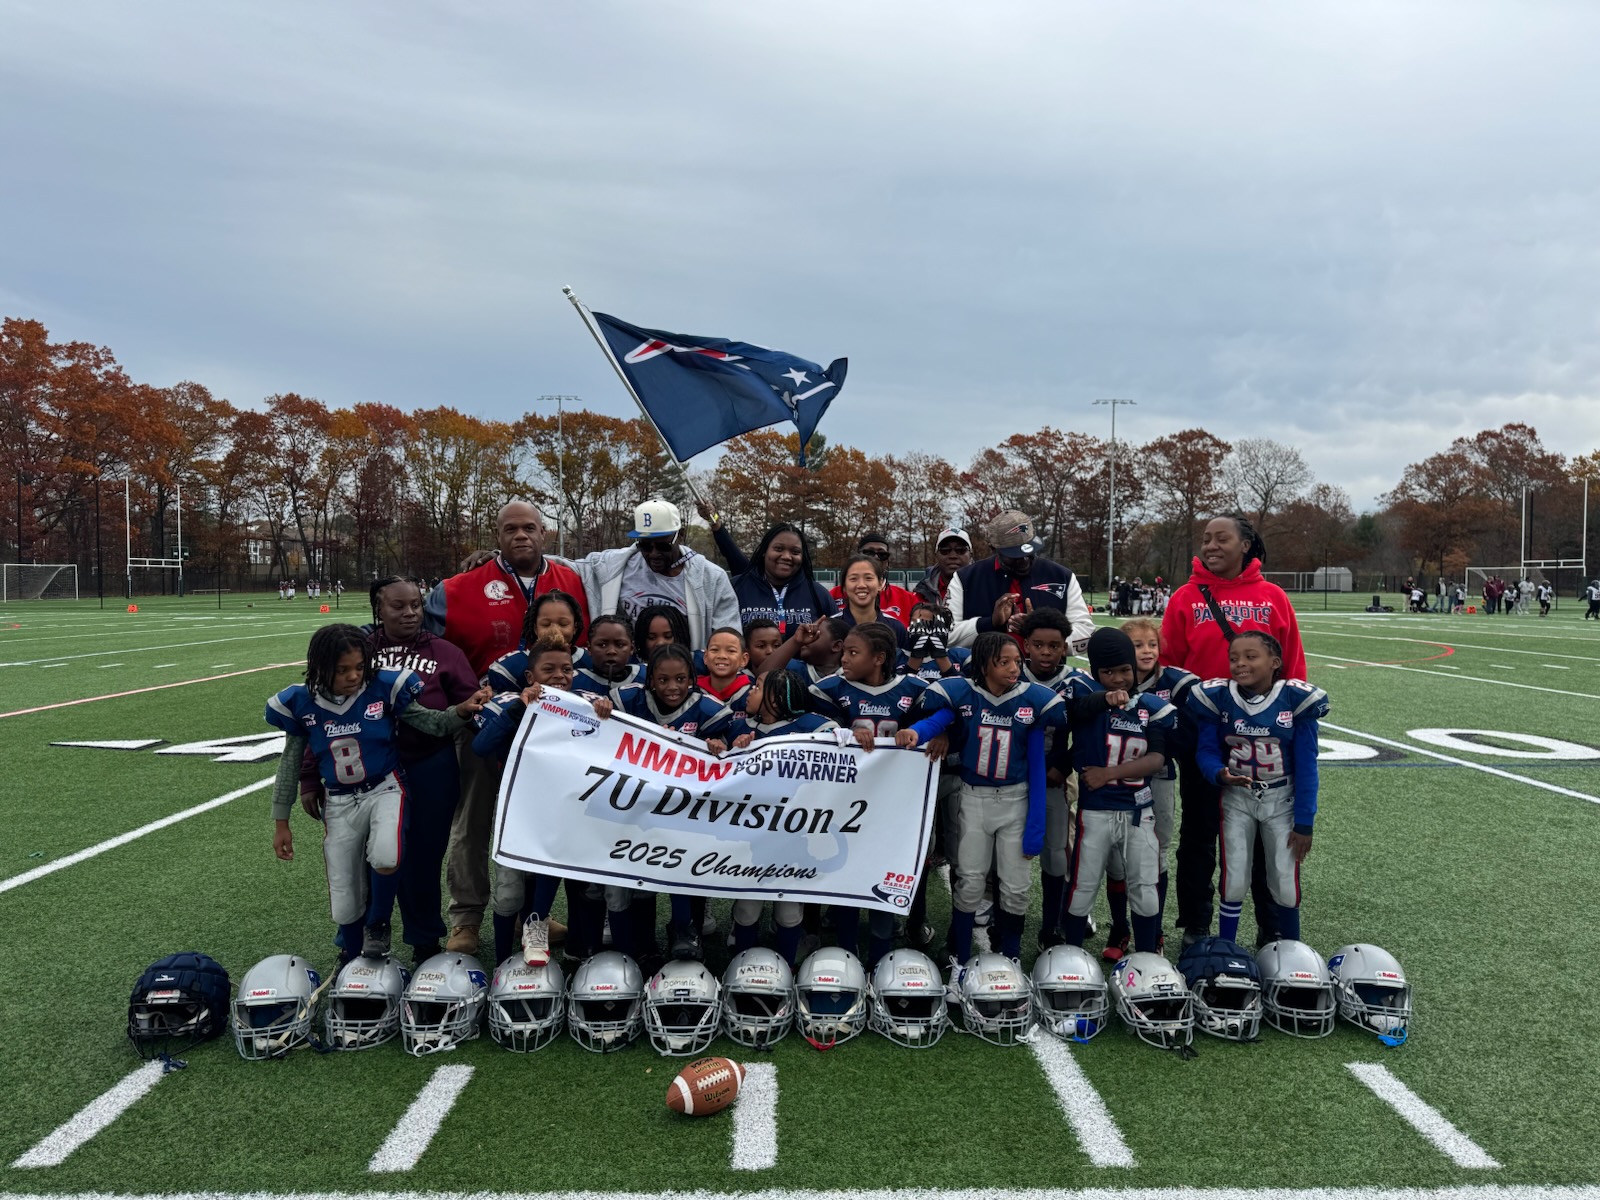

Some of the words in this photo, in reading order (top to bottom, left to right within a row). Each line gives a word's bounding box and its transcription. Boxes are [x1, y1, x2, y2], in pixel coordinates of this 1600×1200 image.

[643, 513, 652, 527] B
[1194, 605, 1272, 628] PARIOTS
[329, 737, 367, 785] 8
[614, 732, 733, 782] NMPW
[735, 749, 837, 768] NORTHEASTERN
[838, 753, 857, 767] MA
[976, 725, 1012, 780] 11
[1225, 735, 1285, 780] 29
[732, 759, 774, 776] POP
[777, 760, 858, 784] WARNER
[577, 765, 650, 811] 7U
[650, 784, 835, 834] Division
[839, 799, 868, 834] 2
[609, 839, 688, 869] 2025
[690, 851, 818, 883] Champions
[883, 881, 911, 889] WARNER
[884, 871, 914, 884] POP
[704, 1087, 730, 1102] Wilson
